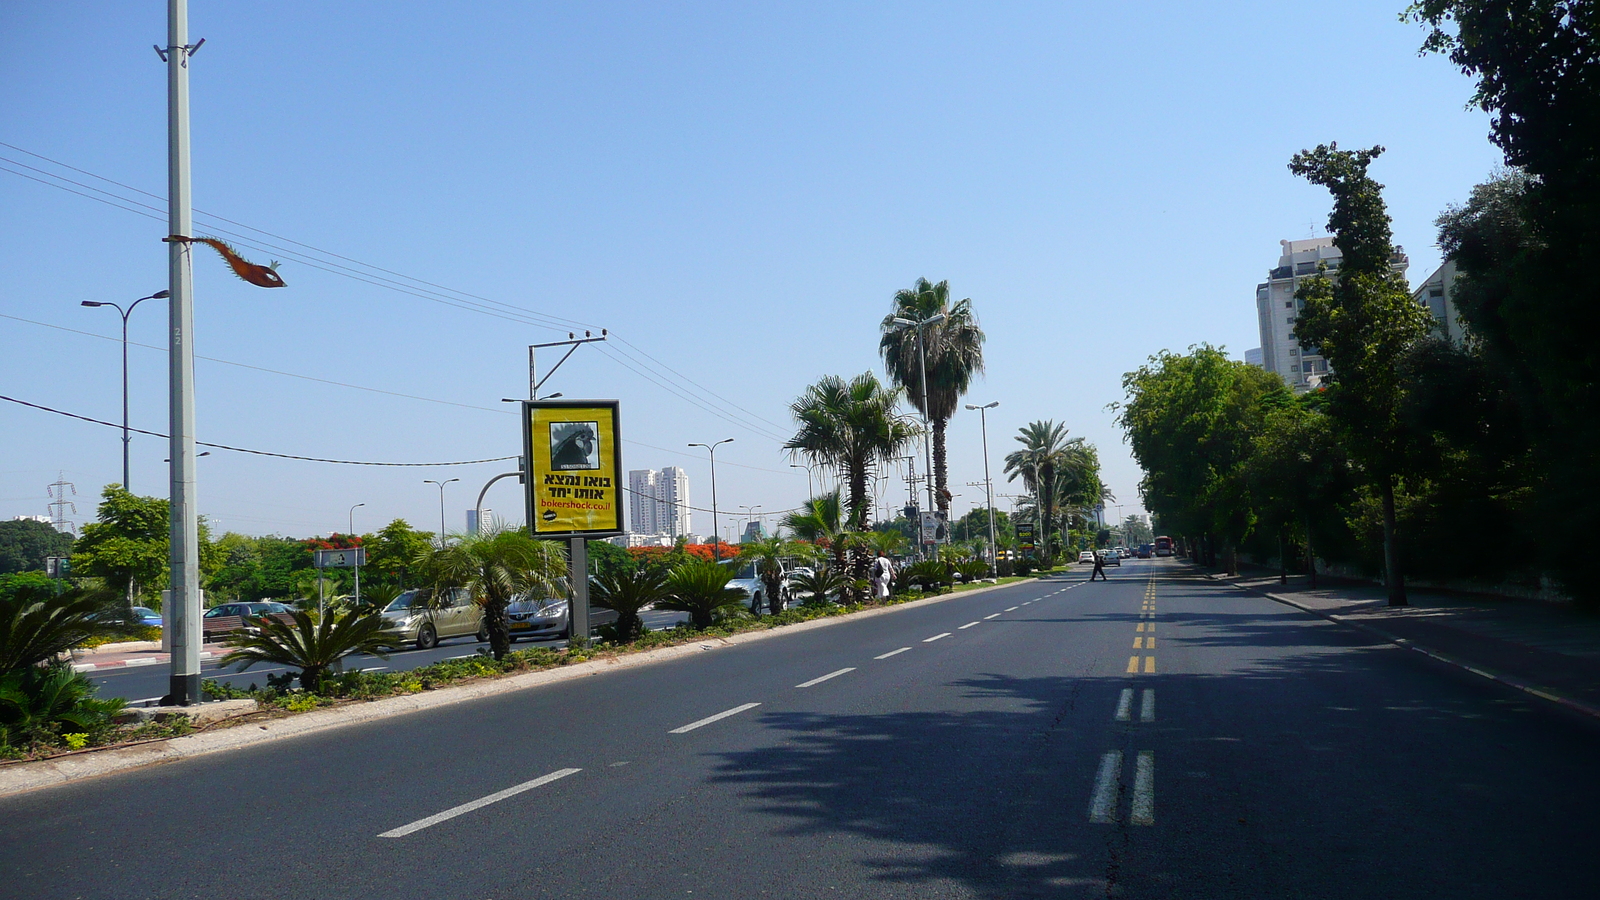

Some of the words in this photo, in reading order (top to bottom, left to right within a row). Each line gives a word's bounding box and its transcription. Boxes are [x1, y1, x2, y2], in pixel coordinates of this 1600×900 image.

[544, 474, 581, 486] נמצא
[583, 477, 611, 487] בואו
[548, 487, 571, 498] יחד
[574, 488, 604, 499] אותו
[541, 499, 611, 510] bokershock.co.il
